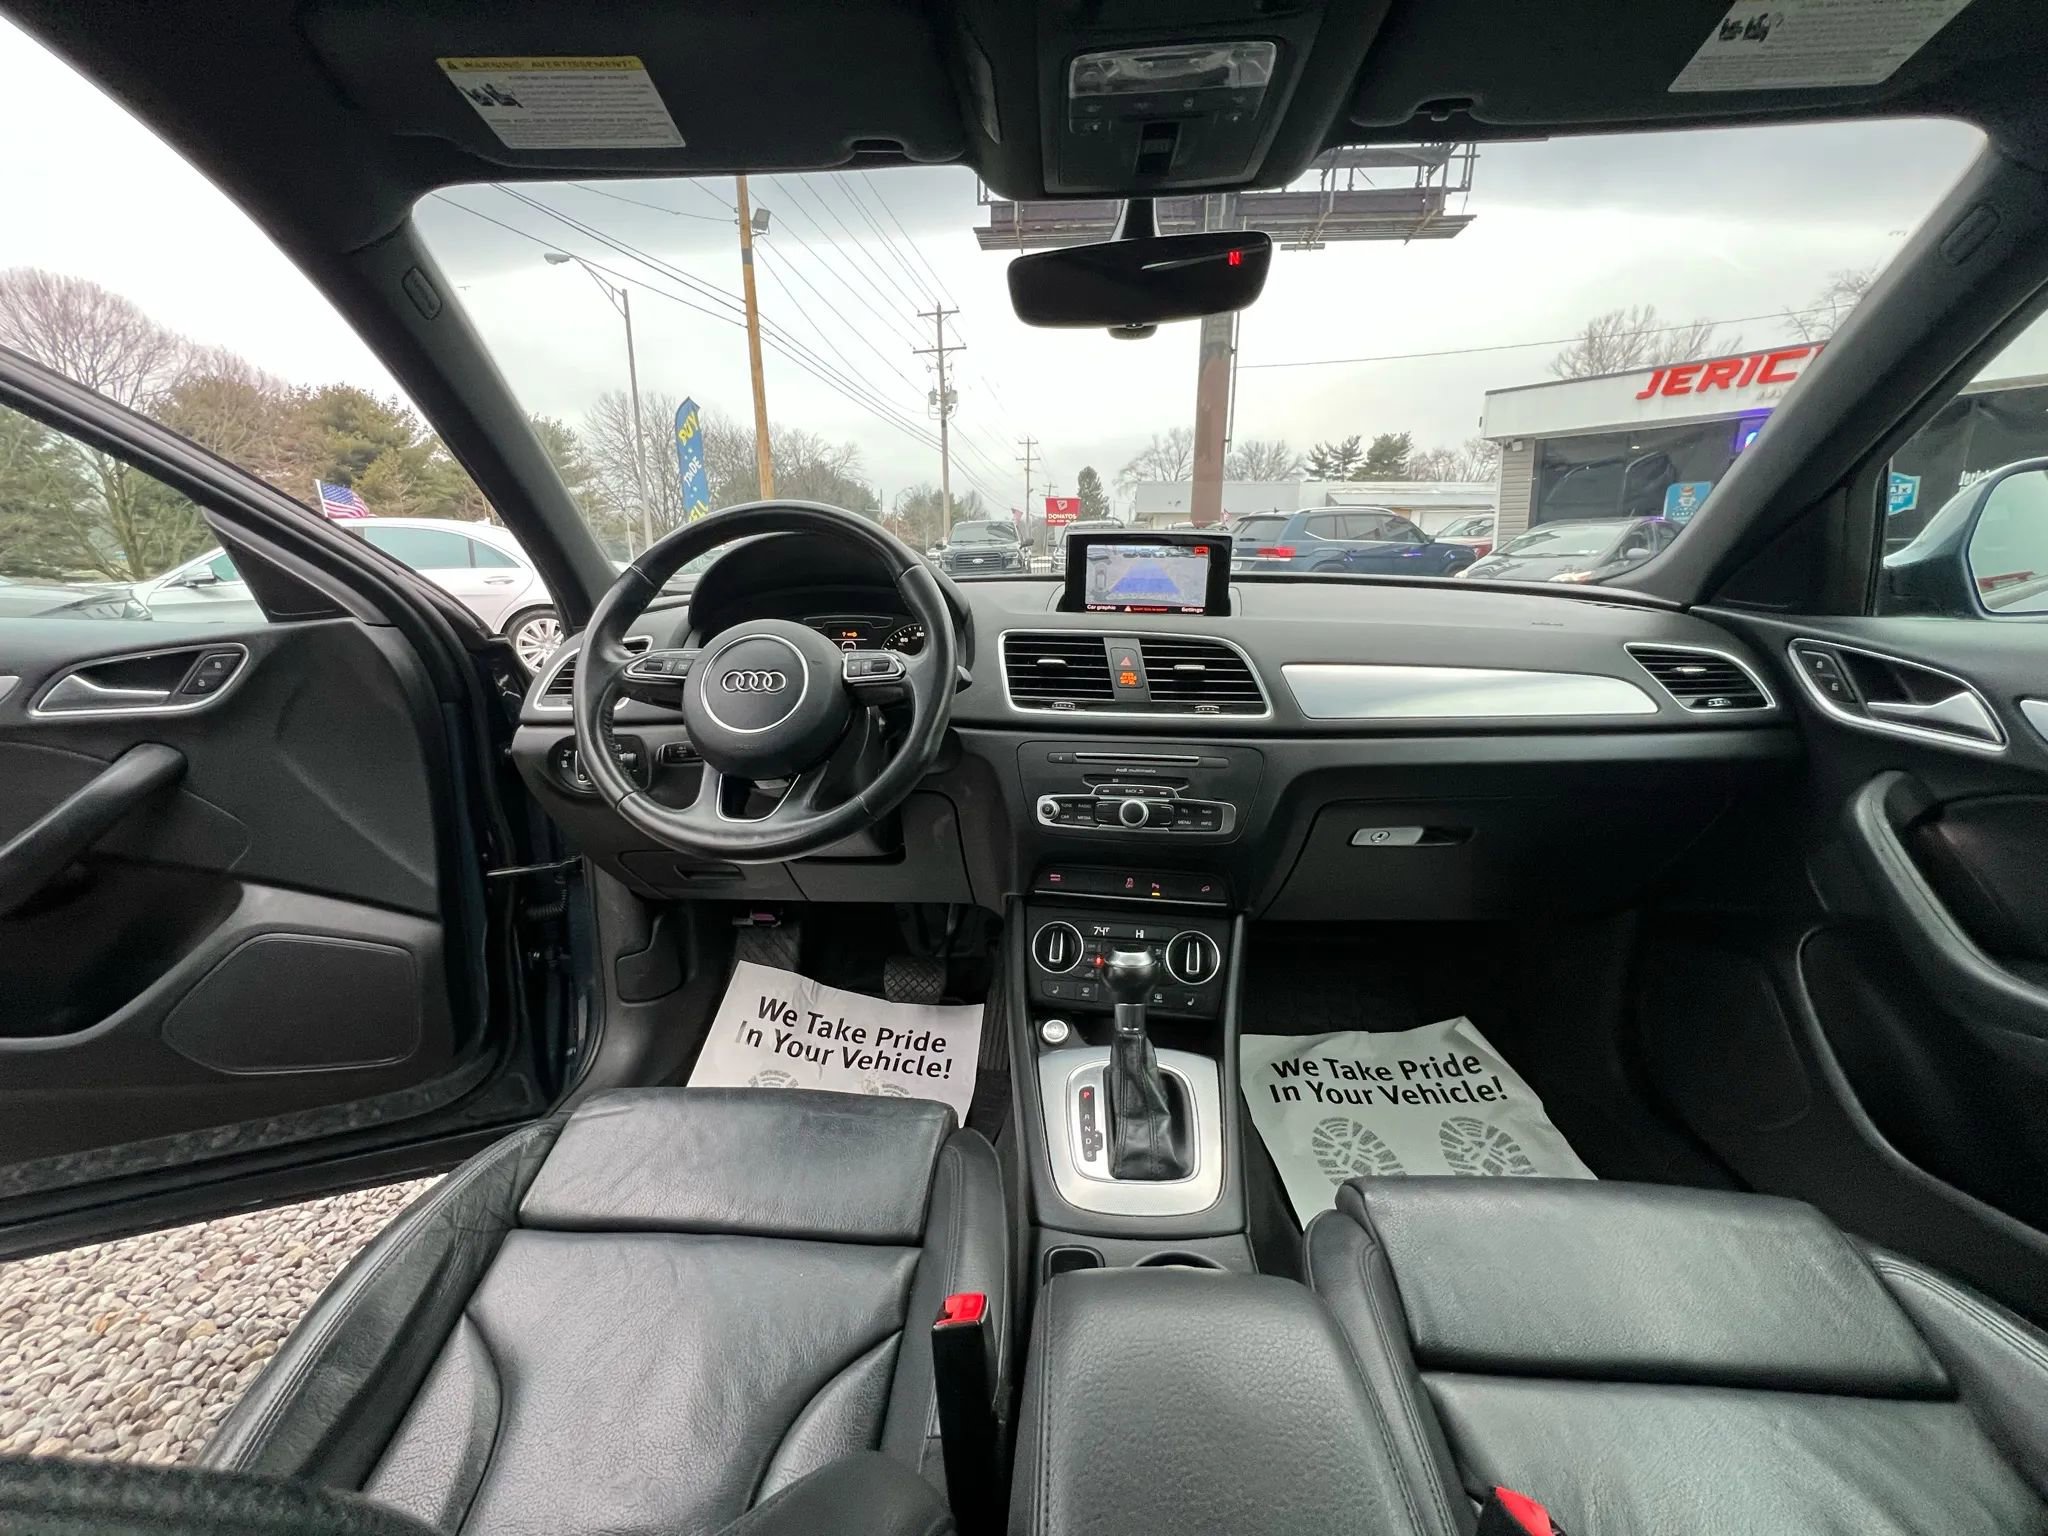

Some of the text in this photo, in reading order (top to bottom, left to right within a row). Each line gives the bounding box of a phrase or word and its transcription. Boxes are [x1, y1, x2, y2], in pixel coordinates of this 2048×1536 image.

[1228, 251, 1240, 265] N
[1635, 344, 1825, 400] JERIC
[678, 411, 698, 446] BUY
[758, 995, 946, 1053] We Take Pride
[735, 1020, 952, 1079] In Your Vehicle!
[1271, 1052, 1482, 1081] We Take Pride
[1270, 1075, 1508, 1106] In Your Vehicle!
